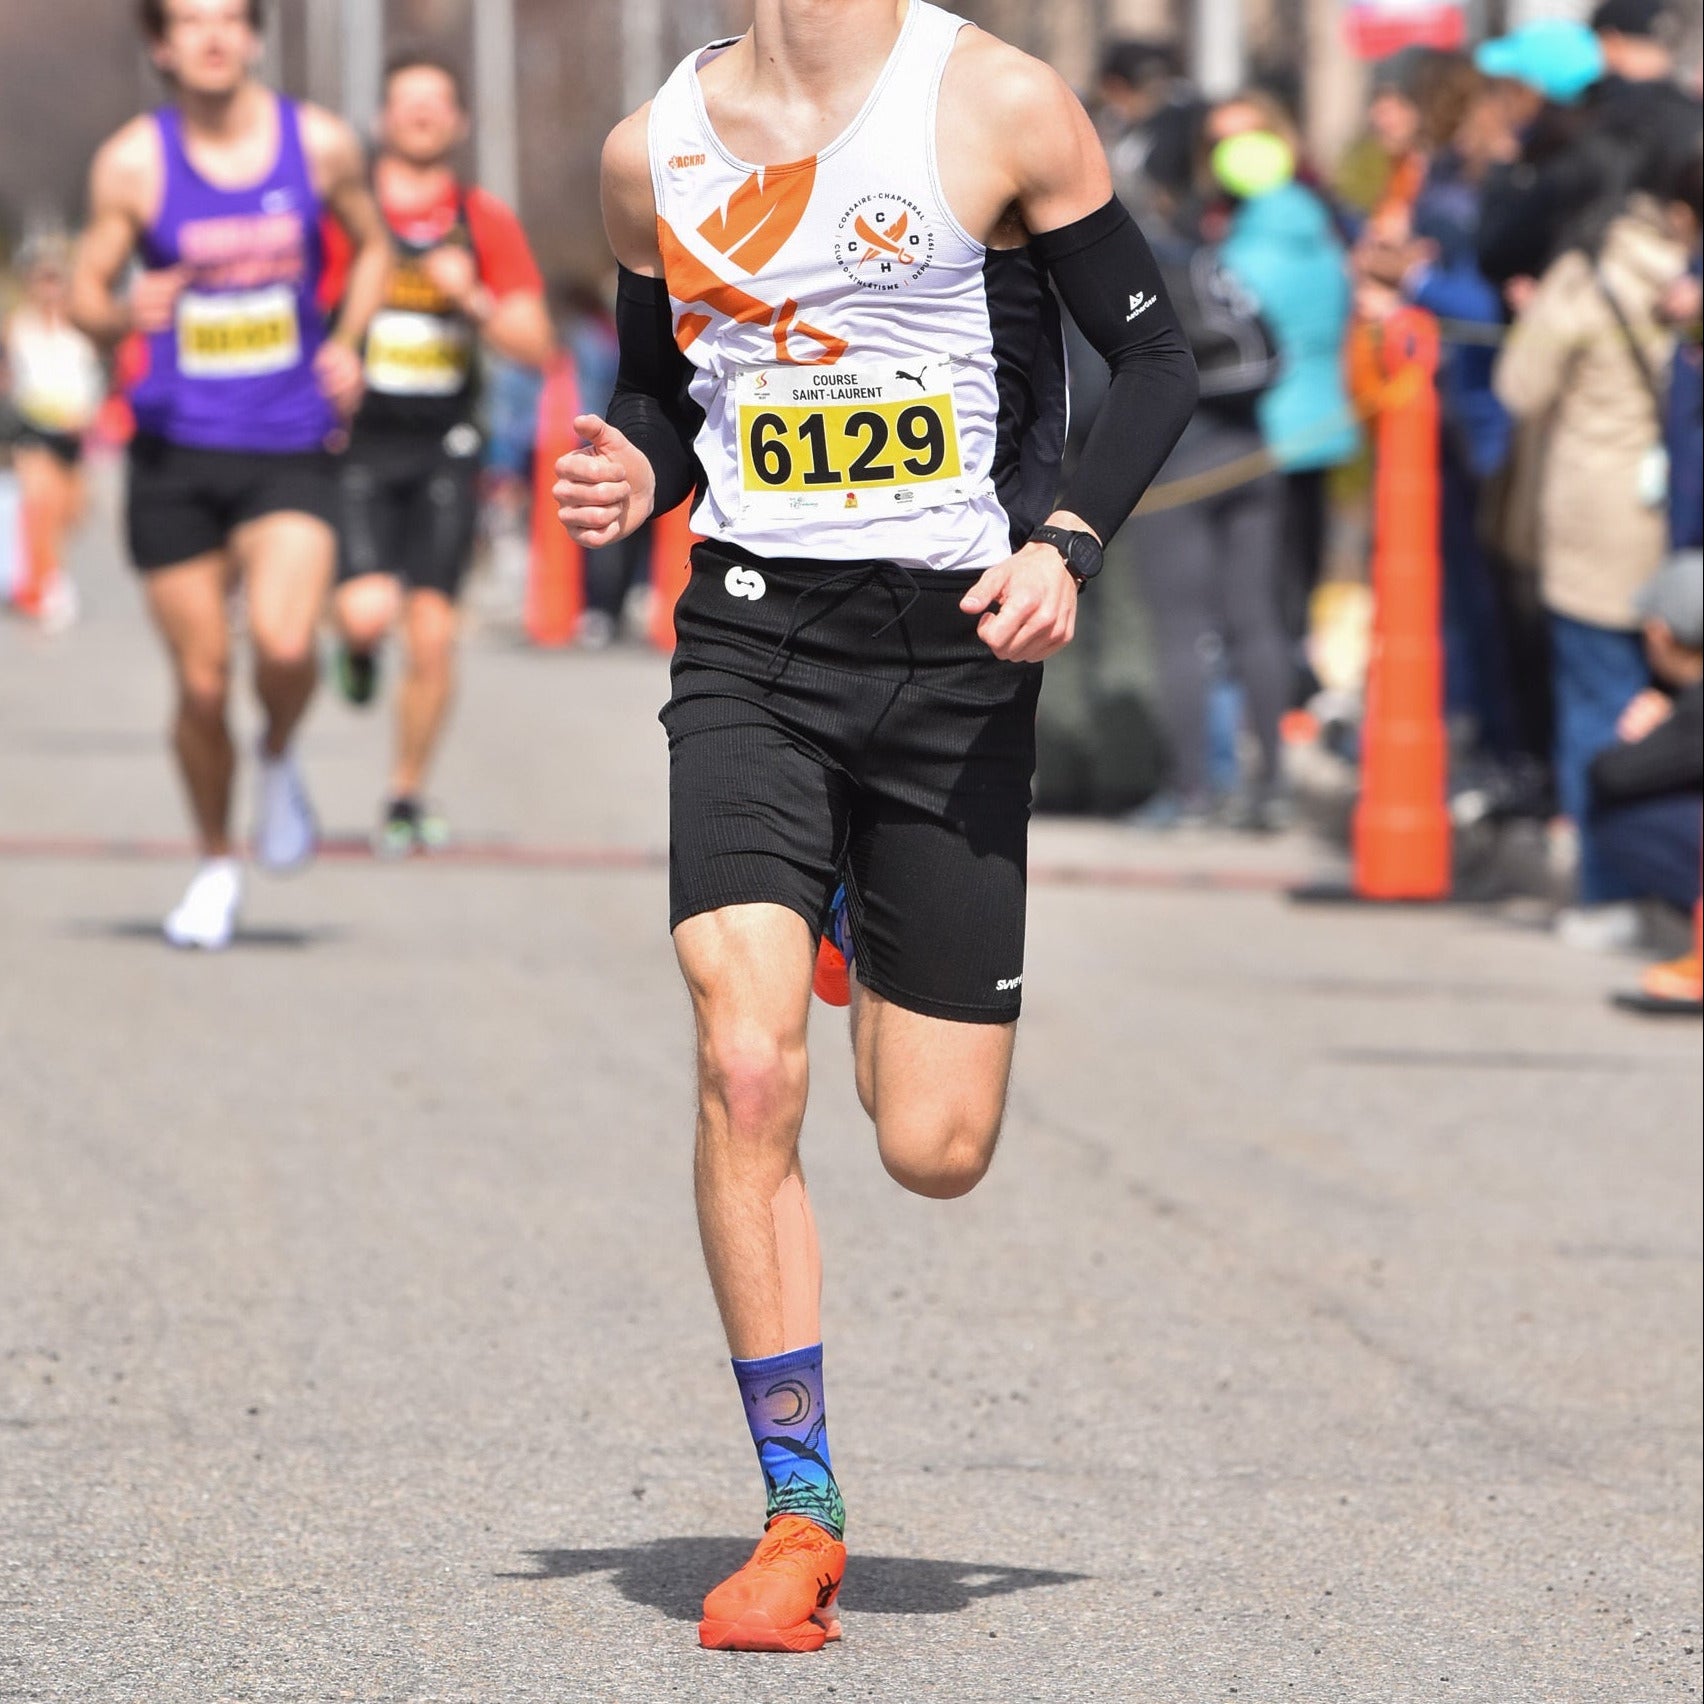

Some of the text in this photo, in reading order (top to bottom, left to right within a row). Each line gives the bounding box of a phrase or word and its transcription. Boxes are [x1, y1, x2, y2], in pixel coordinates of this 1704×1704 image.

[838, 192, 925, 229] CORSAIRE-CHAPARRAL
[912, 254, 933, 280] DEPUIS
[812, 373, 859, 386] COURSE
[792, 386, 883, 401] SAINT-LAURENT
[750, 405, 945, 485] 6129
